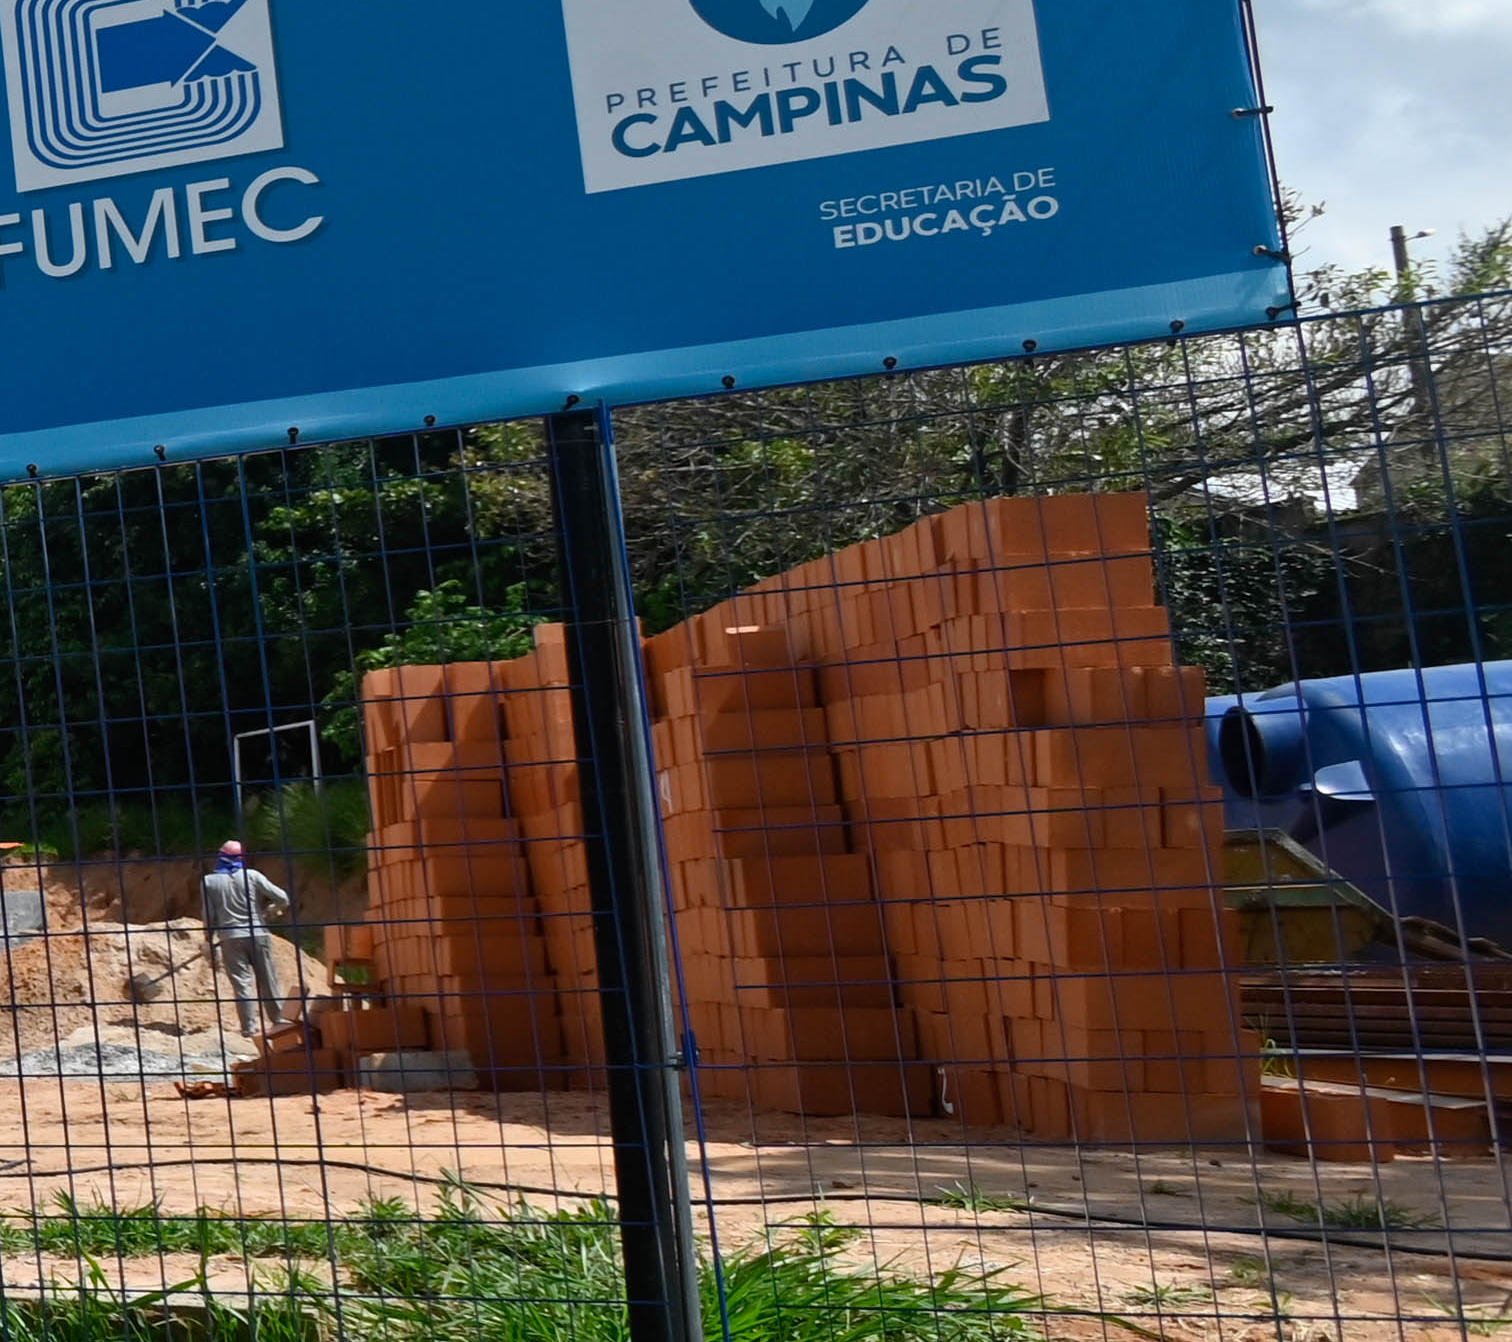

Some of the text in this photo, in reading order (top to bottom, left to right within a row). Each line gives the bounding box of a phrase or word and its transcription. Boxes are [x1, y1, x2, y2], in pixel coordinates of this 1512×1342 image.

[604, 25, 1004, 113] PREFEITURA DE
[610, 54, 1008, 159] CAMPINAS
[818, 166, 1057, 221] SECRETARIA DE
[832, 192, 1061, 250] EDUCAÇÃO
